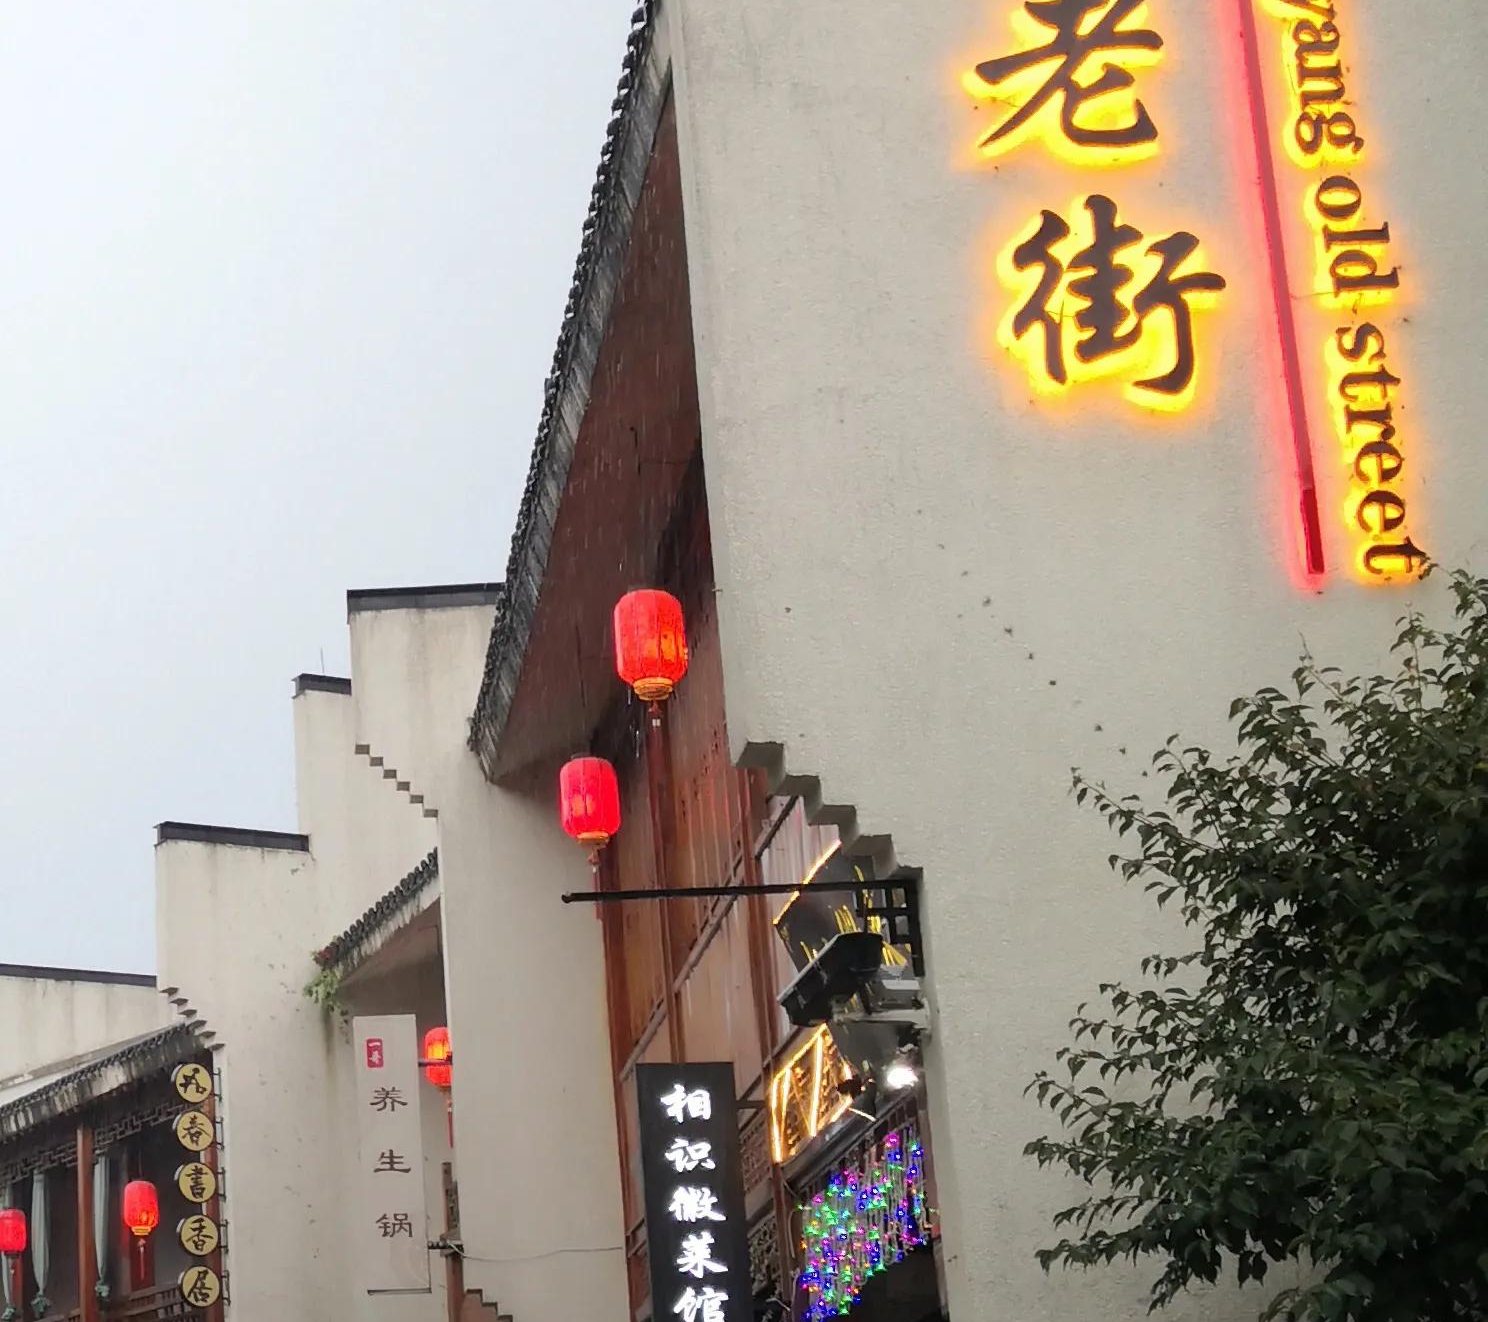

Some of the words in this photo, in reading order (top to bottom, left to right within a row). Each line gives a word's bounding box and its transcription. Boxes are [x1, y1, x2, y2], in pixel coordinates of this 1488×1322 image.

[1314, 174, 1400, 298] old
[1334, 320, 1426, 578] street
[369, 1086, 414, 1238] 养生锅
